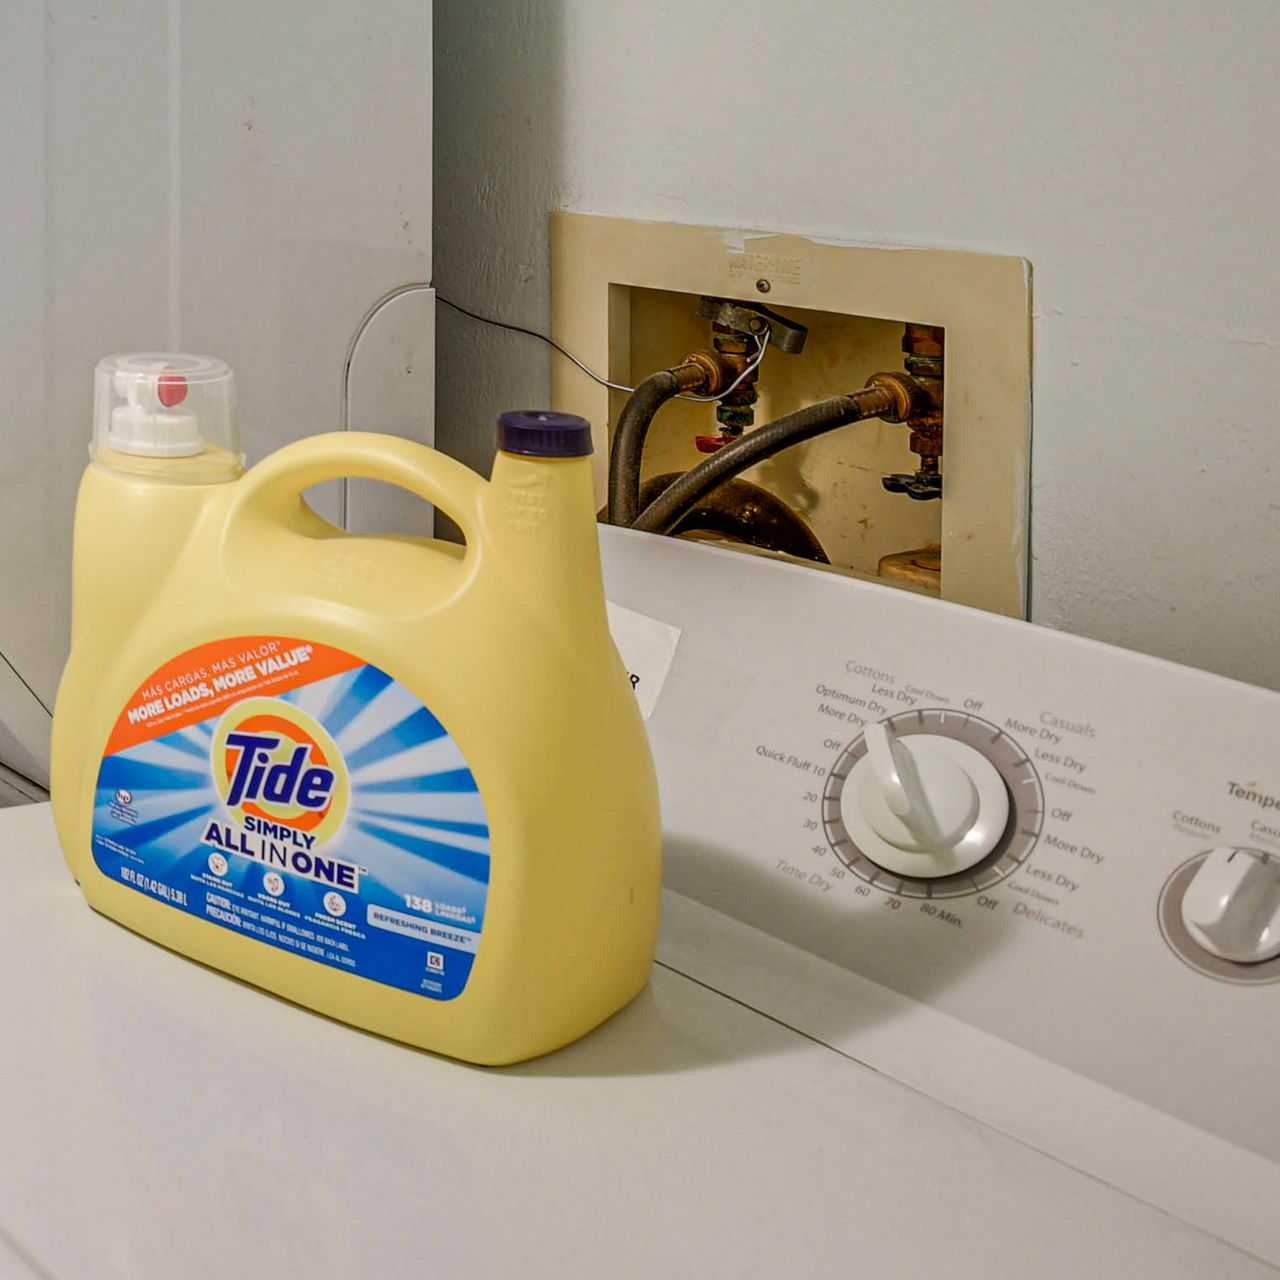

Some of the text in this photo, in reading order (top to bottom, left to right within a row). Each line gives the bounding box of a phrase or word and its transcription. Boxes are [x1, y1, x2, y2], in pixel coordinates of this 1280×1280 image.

[141, 686, 163, 700] MÁS
[164, 668, 211, 691] CARGAS,
[211, 655, 237, 674] MÁS
[845, 660, 896, 685] Cottons
[128, 703, 165, 725] MORE
[164, 683, 215, 710] LOADS,
[213, 665, 257, 691] MORE
[816, 684, 888, 715] Optimum Dry
[871, 683, 918, 706] Less Dry
[963, 698, 984, 711] Off
[818, 703, 867, 728] More Dry
[1040, 711, 1097, 738] Casuals
[1005, 718, 1063, 745] More Dry
[823, 738, 842, 752] Off
[225, 731, 337, 810] Tide
[756, 745, 825, 776] Quick Fluff 10
[1034, 748, 1088, 774] Less Dry
[803, 791, 818, 803] 20
[803, 819, 818, 831] 30
[1051, 808, 1073, 822] Off
[1172, 810, 1221, 834] Cottons
[205, 822, 255, 857] ALL
[261, 840, 287, 868] IN
[244, 816, 316, 850] SIMPLY
[812, 845, 827, 857] 40
[1044, 834, 1104, 864] More Dry
[775, 859, 833, 892] Time Dry
[829, 867, 846, 880] 50
[1026, 864, 1080, 892] Less Dry
[404, 894, 433, 913] 138
[854, 884, 871, 898] 60
[977, 895, 998, 910] Off
[885, 898, 902, 910] 70
[920, 903, 936, 917] 80
[373, 912, 428, 934] REFRESHING
[1013, 902, 1084, 938] Delicates
